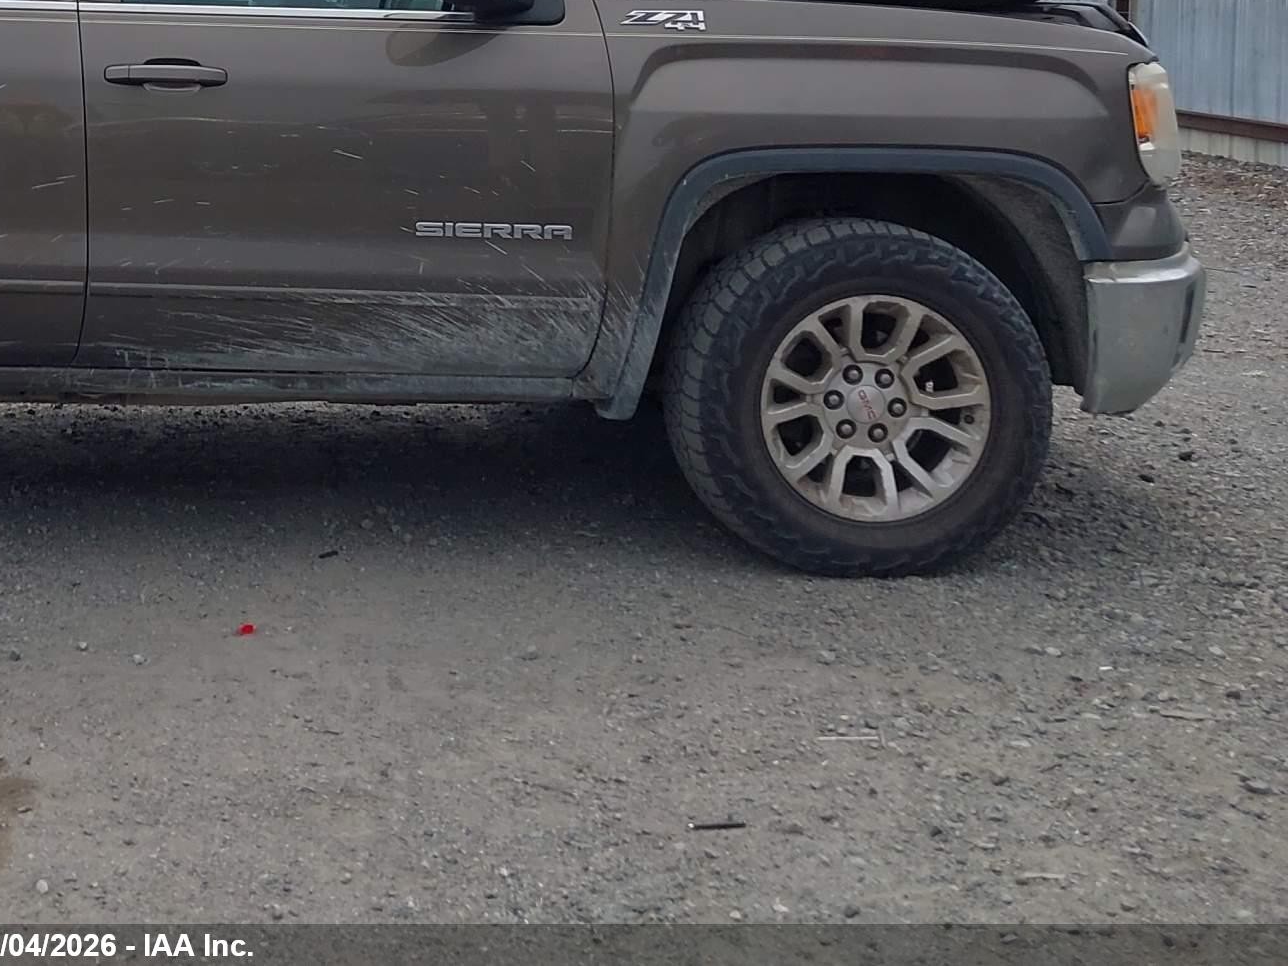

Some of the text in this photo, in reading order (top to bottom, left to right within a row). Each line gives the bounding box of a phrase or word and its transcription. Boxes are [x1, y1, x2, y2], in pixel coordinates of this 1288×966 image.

[620, 9, 705, 25] Z71
[415, 221, 573, 240] SIERRA
[857, 389, 877, 421] GMC
